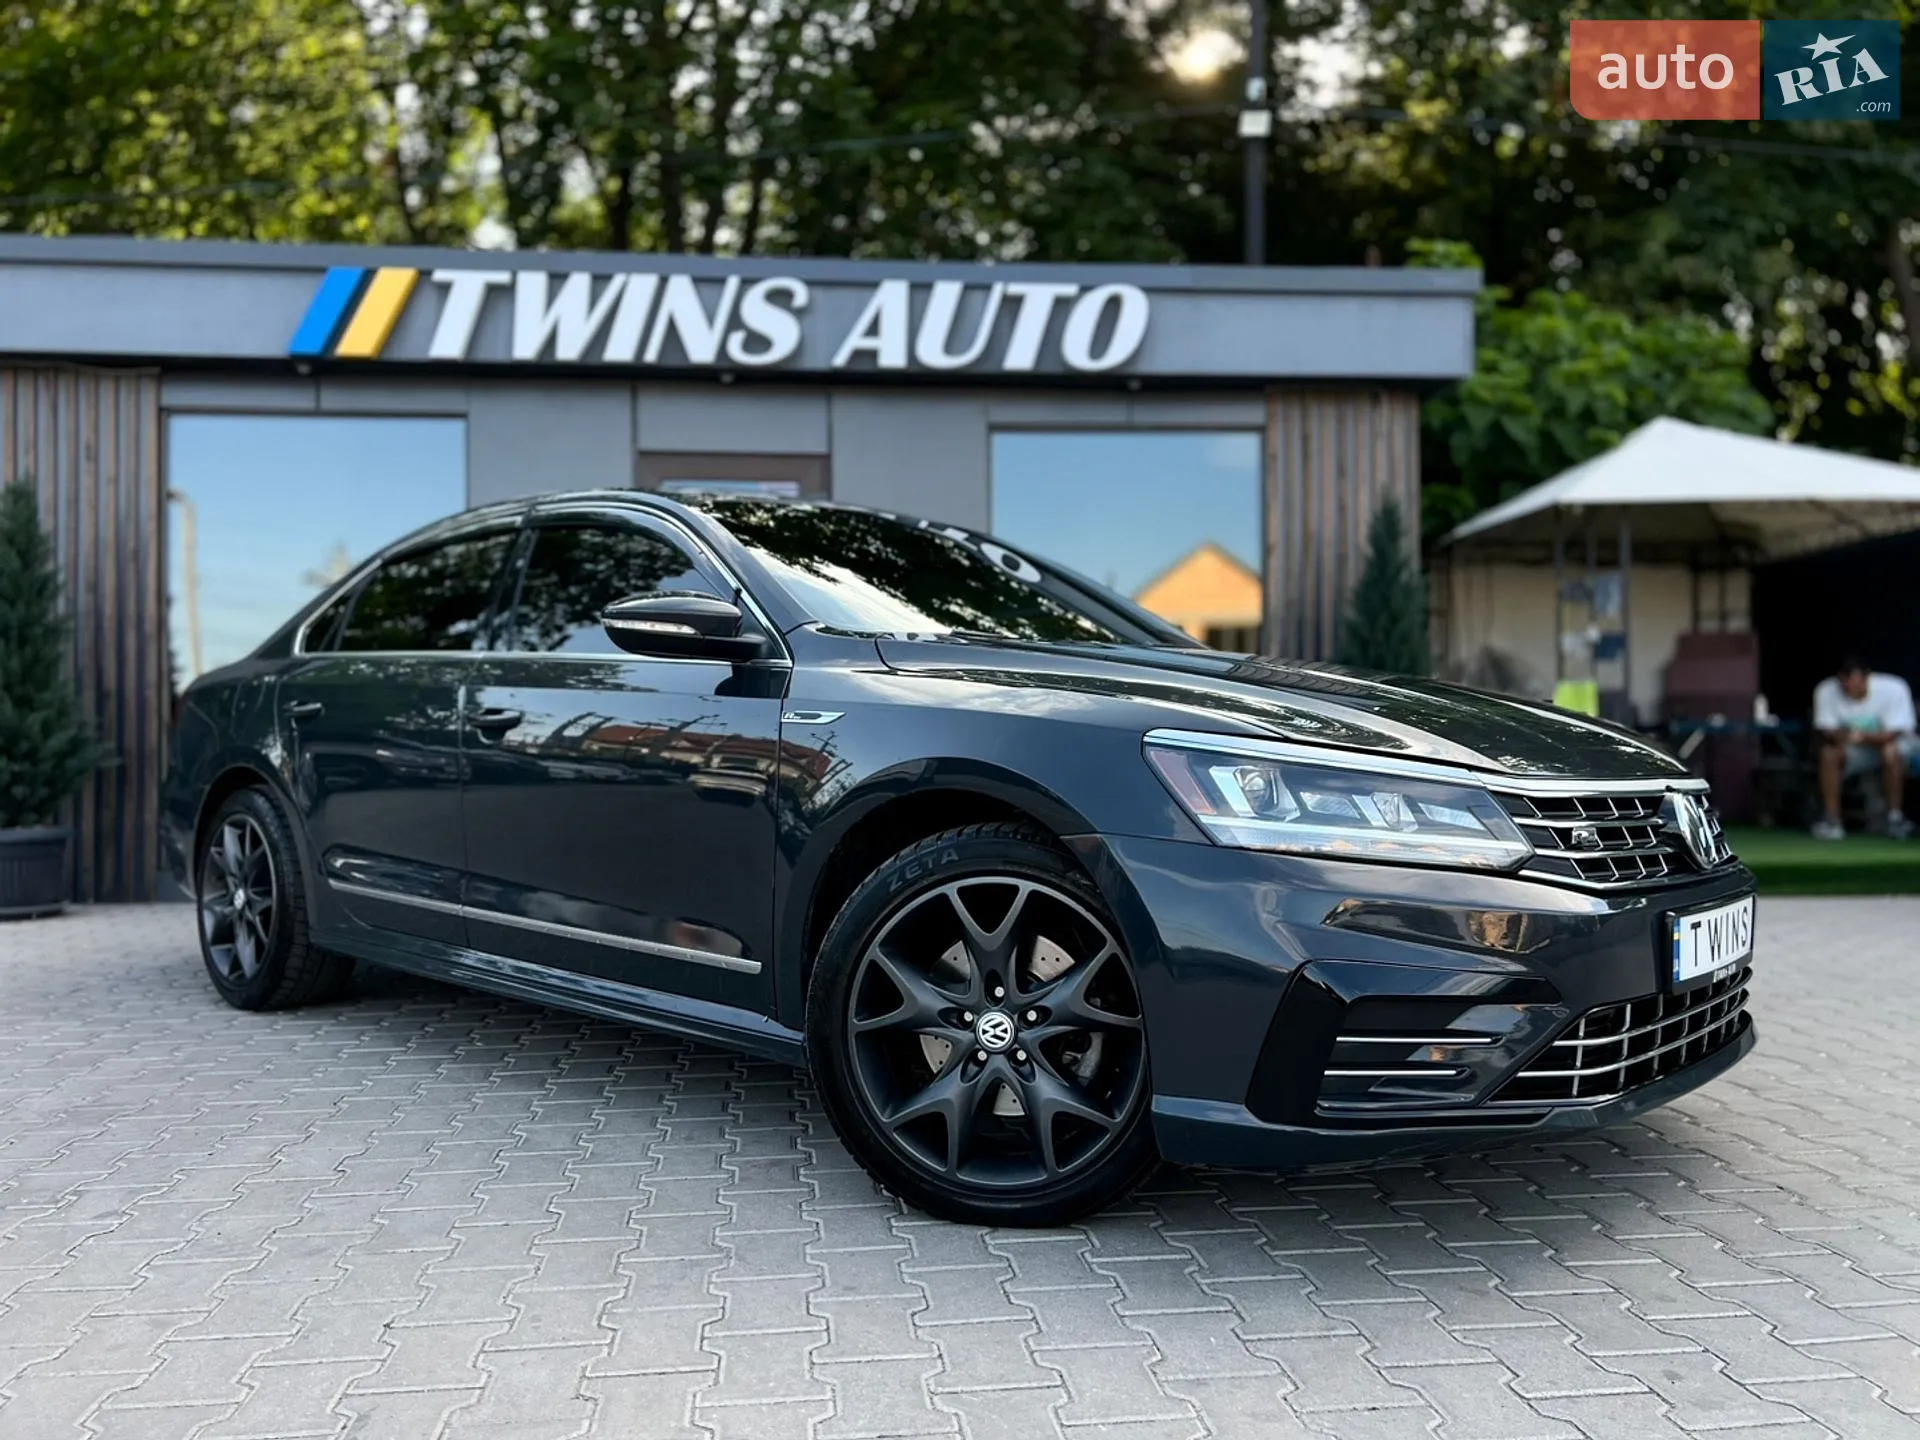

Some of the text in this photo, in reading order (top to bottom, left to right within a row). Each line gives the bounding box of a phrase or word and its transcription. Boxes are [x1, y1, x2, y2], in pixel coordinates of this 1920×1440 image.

[428, 268, 1150, 372] TWINS AUTO
[886, 849, 959, 892] ZETA
[1690, 905, 1748, 968] TWINS
